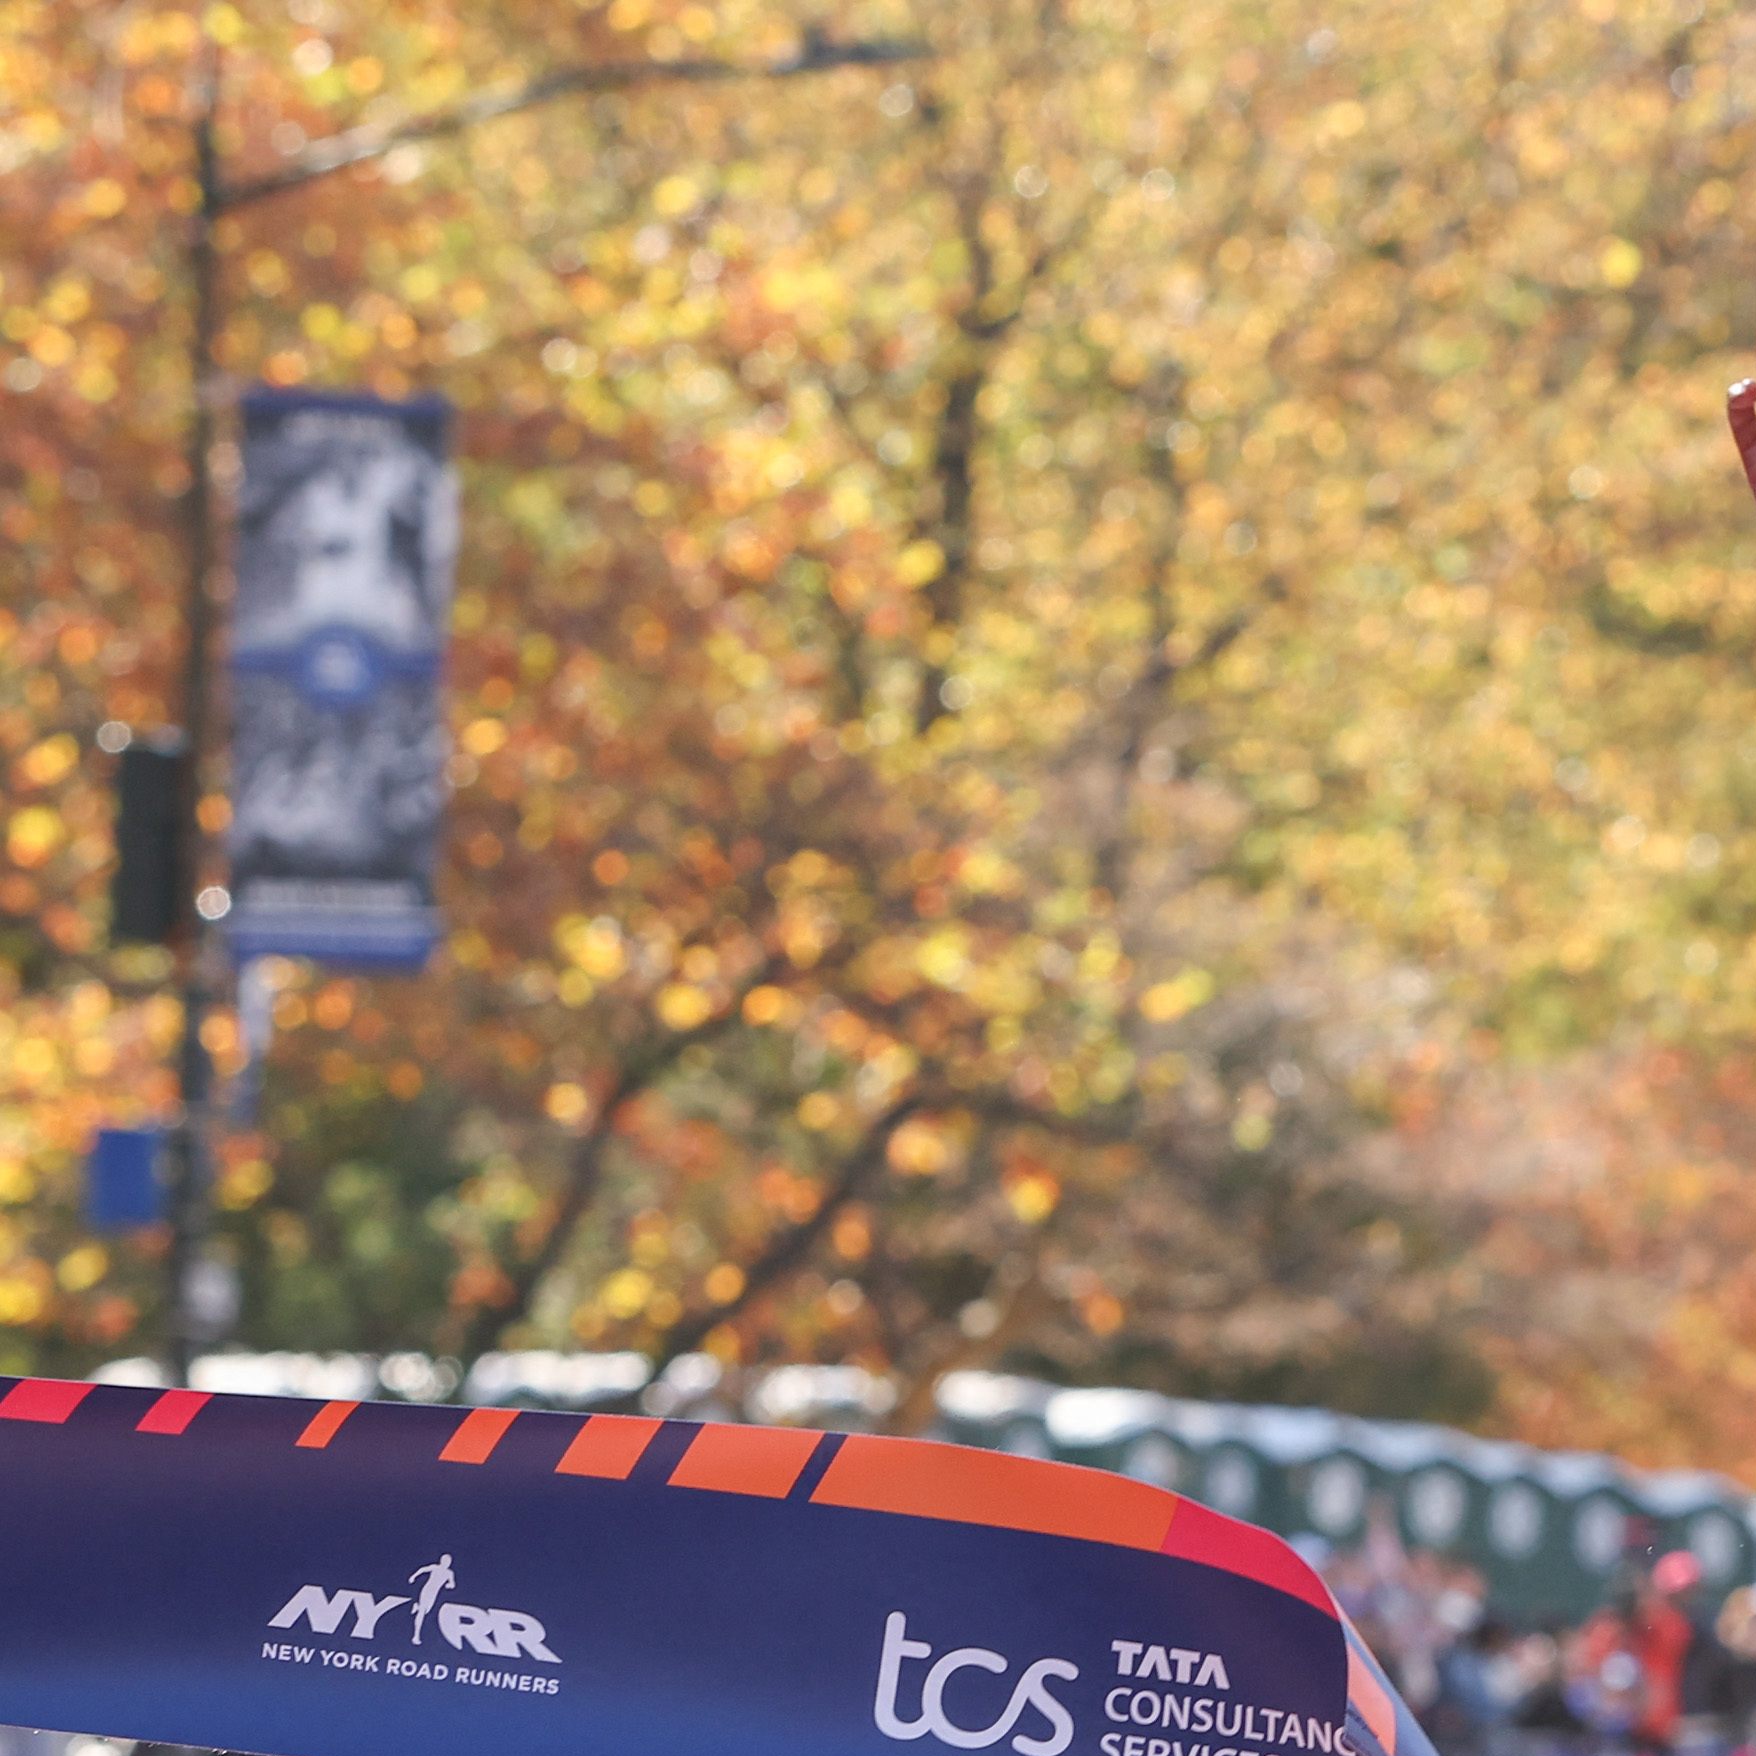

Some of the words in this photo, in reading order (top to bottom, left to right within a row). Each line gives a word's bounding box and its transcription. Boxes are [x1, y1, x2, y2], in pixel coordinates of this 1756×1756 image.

[261, 1642, 315, 1664] NEW
[320, 1649, 380, 1673] YORK
[386, 1658, 448, 1681] ROAD
[455, 1667, 560, 1695] RUNNERS
[1111, 1639, 1230, 1690] TATA
